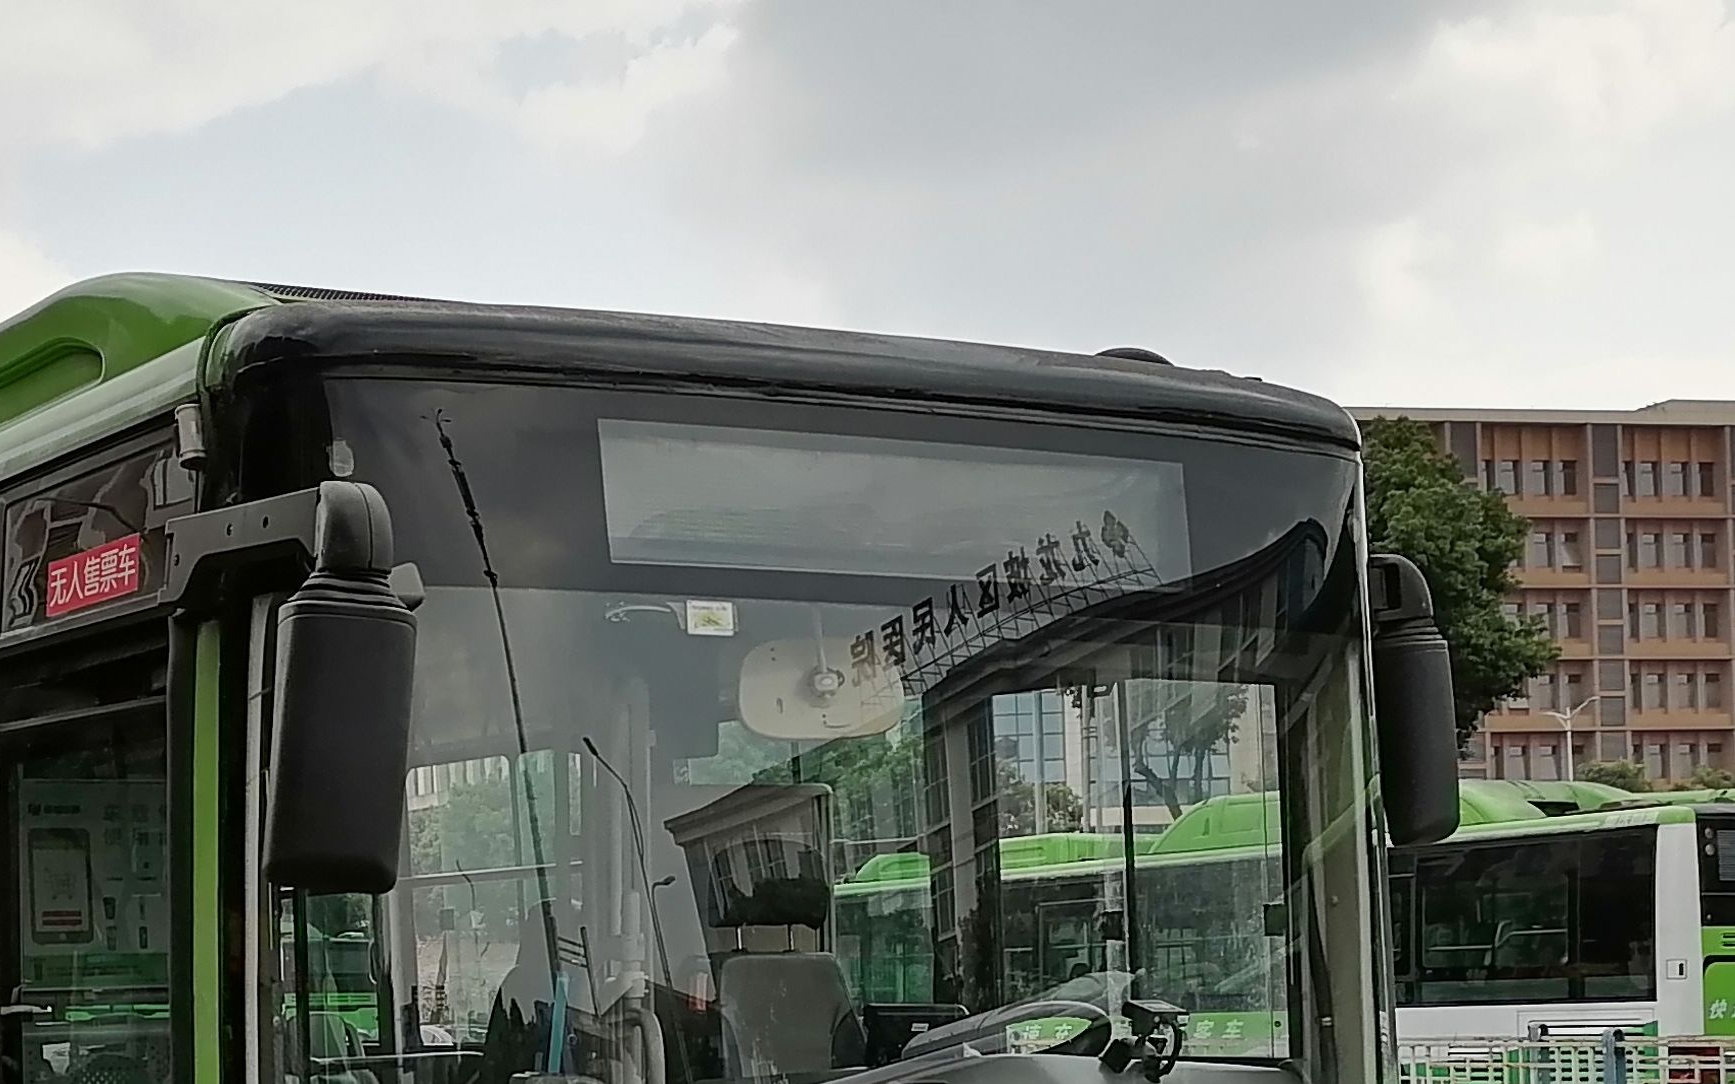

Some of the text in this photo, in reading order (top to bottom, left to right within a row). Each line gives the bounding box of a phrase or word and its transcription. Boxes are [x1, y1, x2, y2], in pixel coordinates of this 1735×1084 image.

[50, 544, 136, 607] 无人售票车
[1709, 999, 1735, 1019] 快
